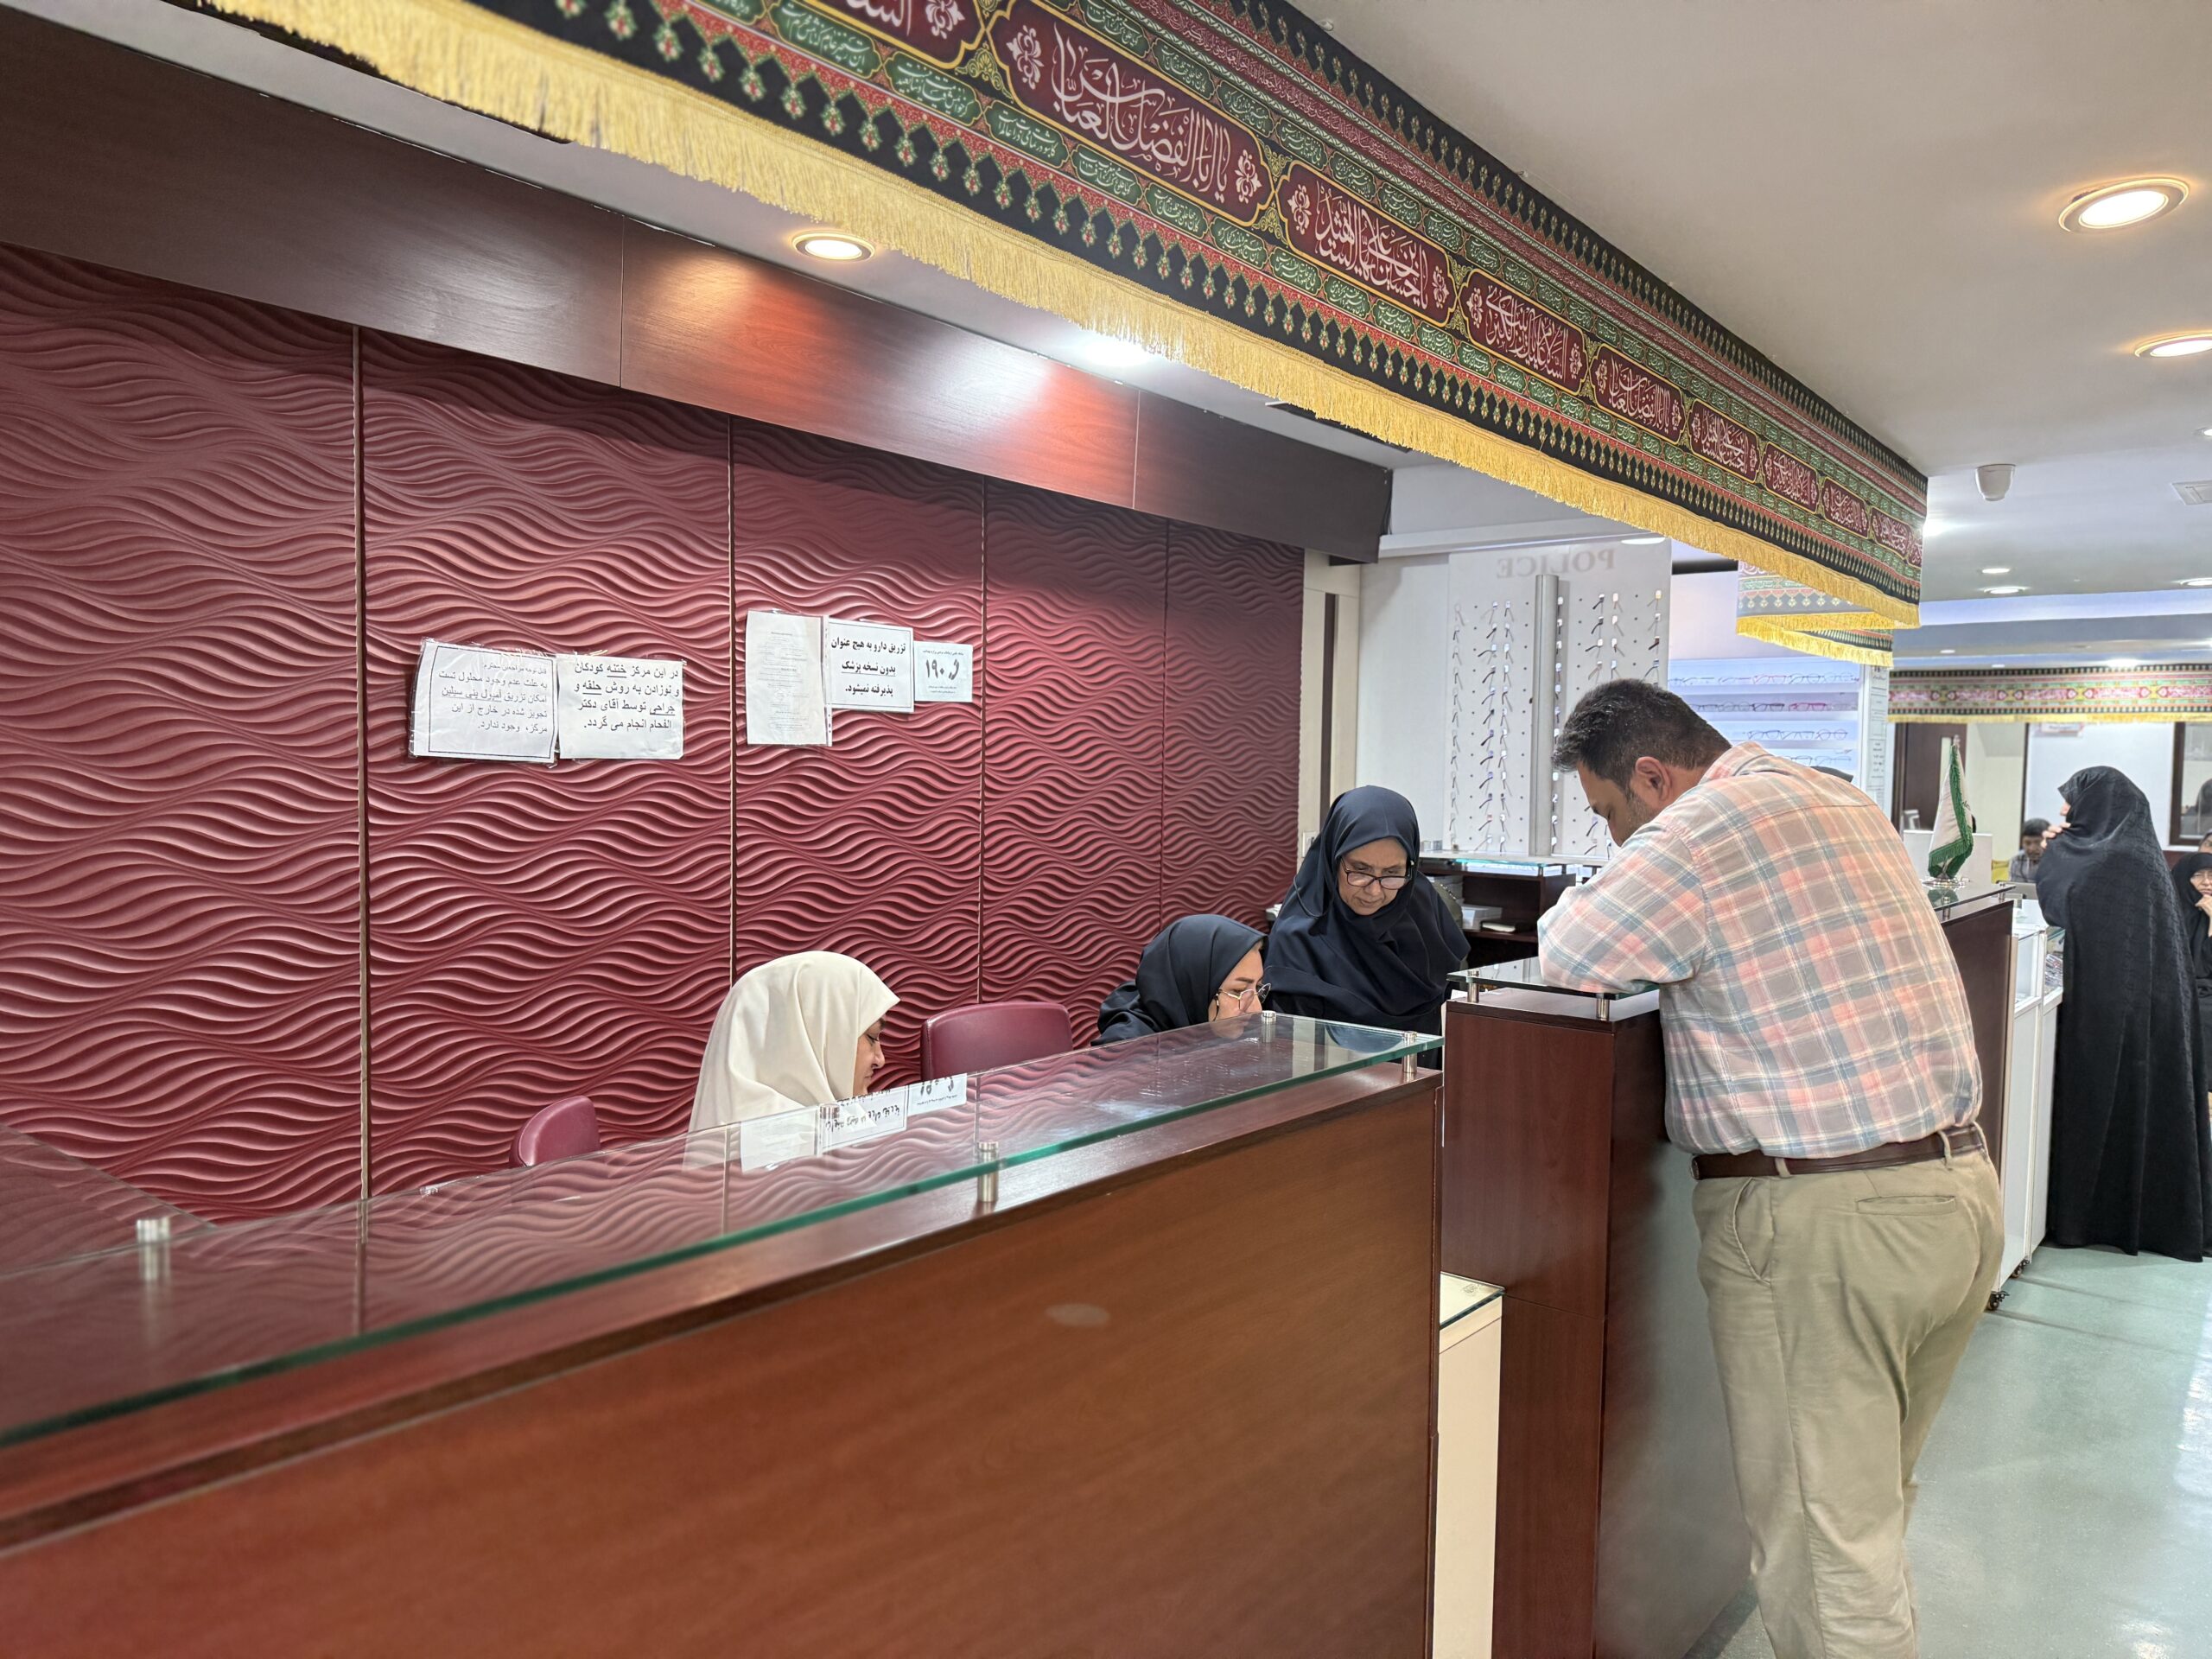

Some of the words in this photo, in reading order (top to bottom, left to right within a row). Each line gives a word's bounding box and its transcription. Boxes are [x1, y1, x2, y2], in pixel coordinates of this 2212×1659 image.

[830, 636, 850, 650] عنوان
[852, 640, 865, 650] هیچ
[866, 642, 873, 652] به
[874, 640, 887, 652] دارو
[888, 643, 906, 654] تزریق
[574, 662, 604, 675] کودکان
[607, 664, 627, 674] ختنه
[630, 665, 651, 677] مرکز
[842, 660, 861, 674] پزشک
[862, 661, 879, 671] نسخه
[880, 664, 896, 676] بدون
[438, 671, 456, 679] تست
[458, 671, 483, 683] محلول
[653, 667, 666, 678] این
[669, 670, 679, 679] در
[485, 677, 506, 686] وجود
[508, 679, 521, 688] عدم
[582, 679, 602, 691] حلقه
[574, 683, 581, 692] و
[605, 681, 630, 694] روش
[632, 684, 642, 696] به
[674, 688, 680, 697] و
[870, 683, 894, 697] پذیرفته
[503, 692, 526, 703] تزریق
[527, 693, 547, 704] امکان
[450, 702, 464, 713] این
[467, 702, 475, 714] از
[477, 705, 499, 716] خارج
[578, 699, 598, 711] دکتر
[621, 699, 647, 713] توسط
[649, 702, 677, 715] جراحی
[501, 708, 512, 716] در
[526, 709, 549, 720] تجویز
[477, 719, 499, 731] ندارد.
[500, 722, 521, 733] وجود
[583, 715, 608, 730] گردد.
[610, 721, 625, 732] می
[626, 718, 648, 733] انجام
[648, 718, 673, 733] الفحام
